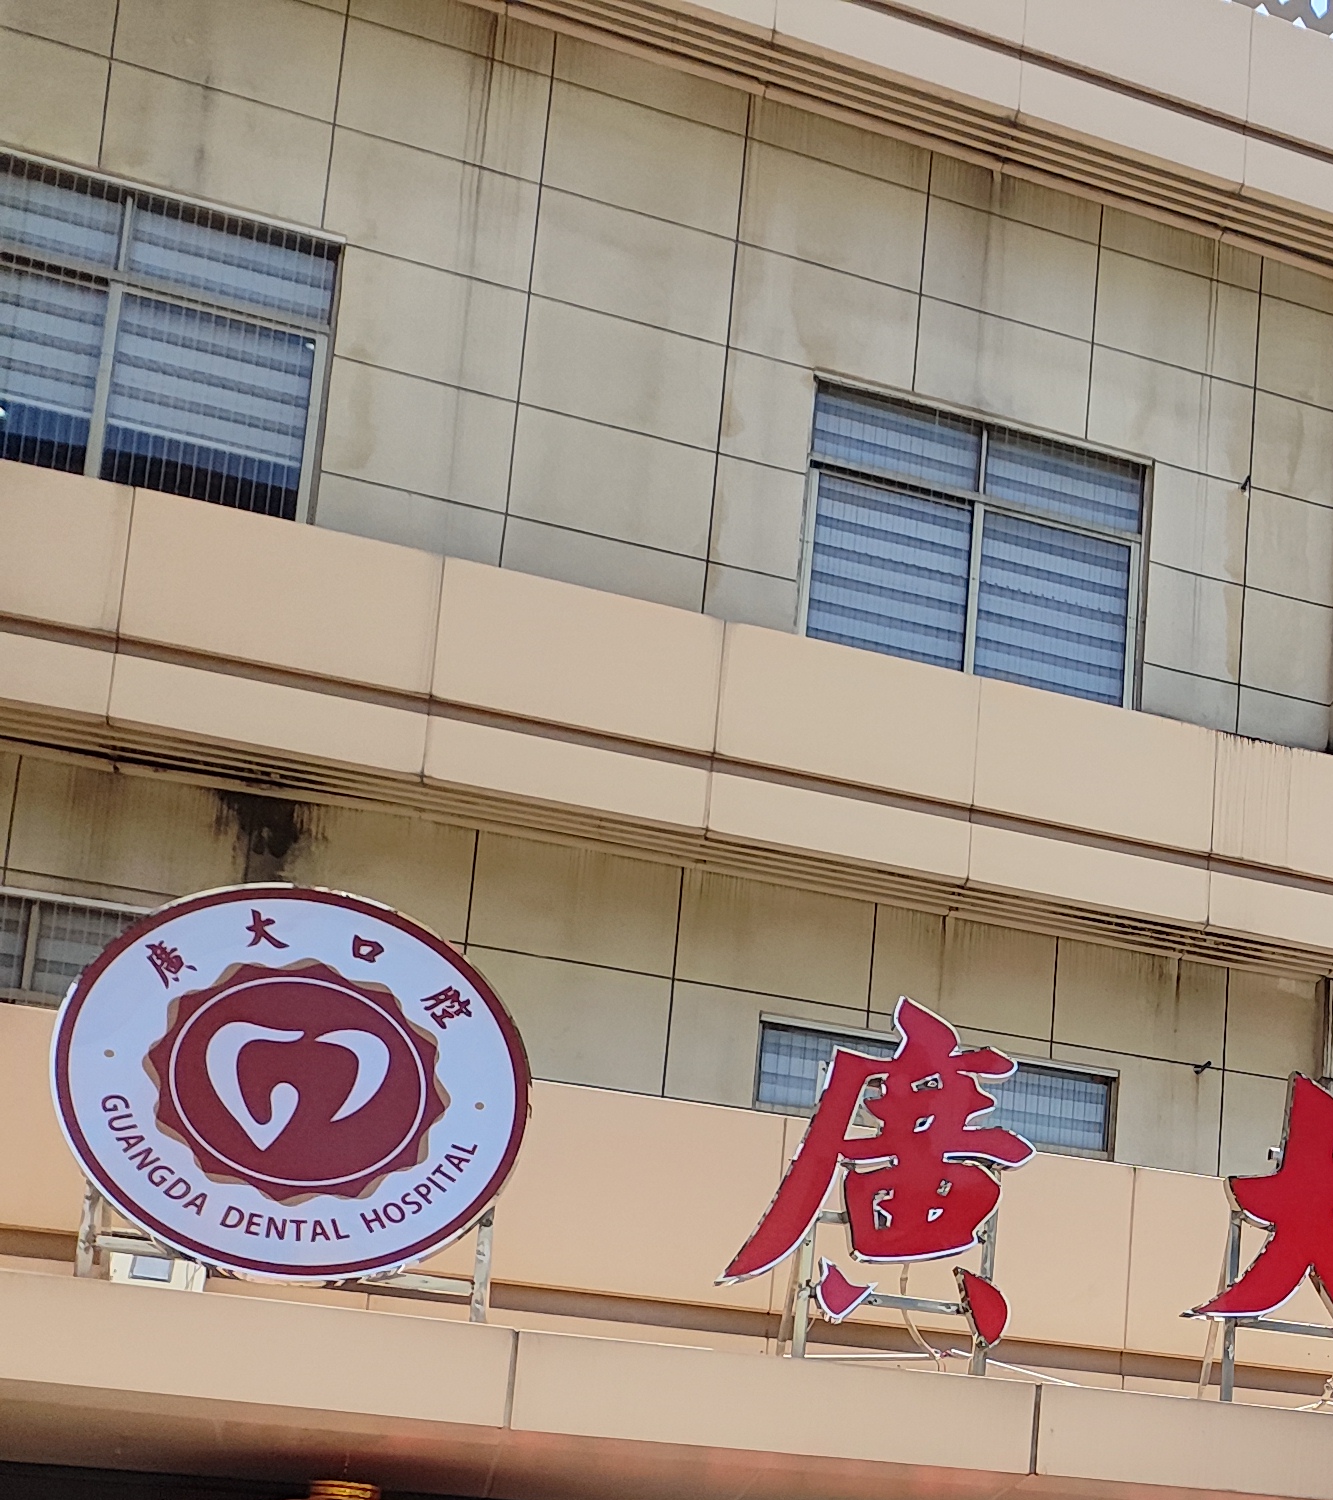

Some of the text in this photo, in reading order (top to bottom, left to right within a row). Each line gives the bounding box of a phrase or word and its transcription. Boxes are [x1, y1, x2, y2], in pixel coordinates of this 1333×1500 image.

[145, 909, 473, 1030] 廣大口腔
[100, 1093, 478, 1243] GUANGDA DENTAL HOSPITAL
